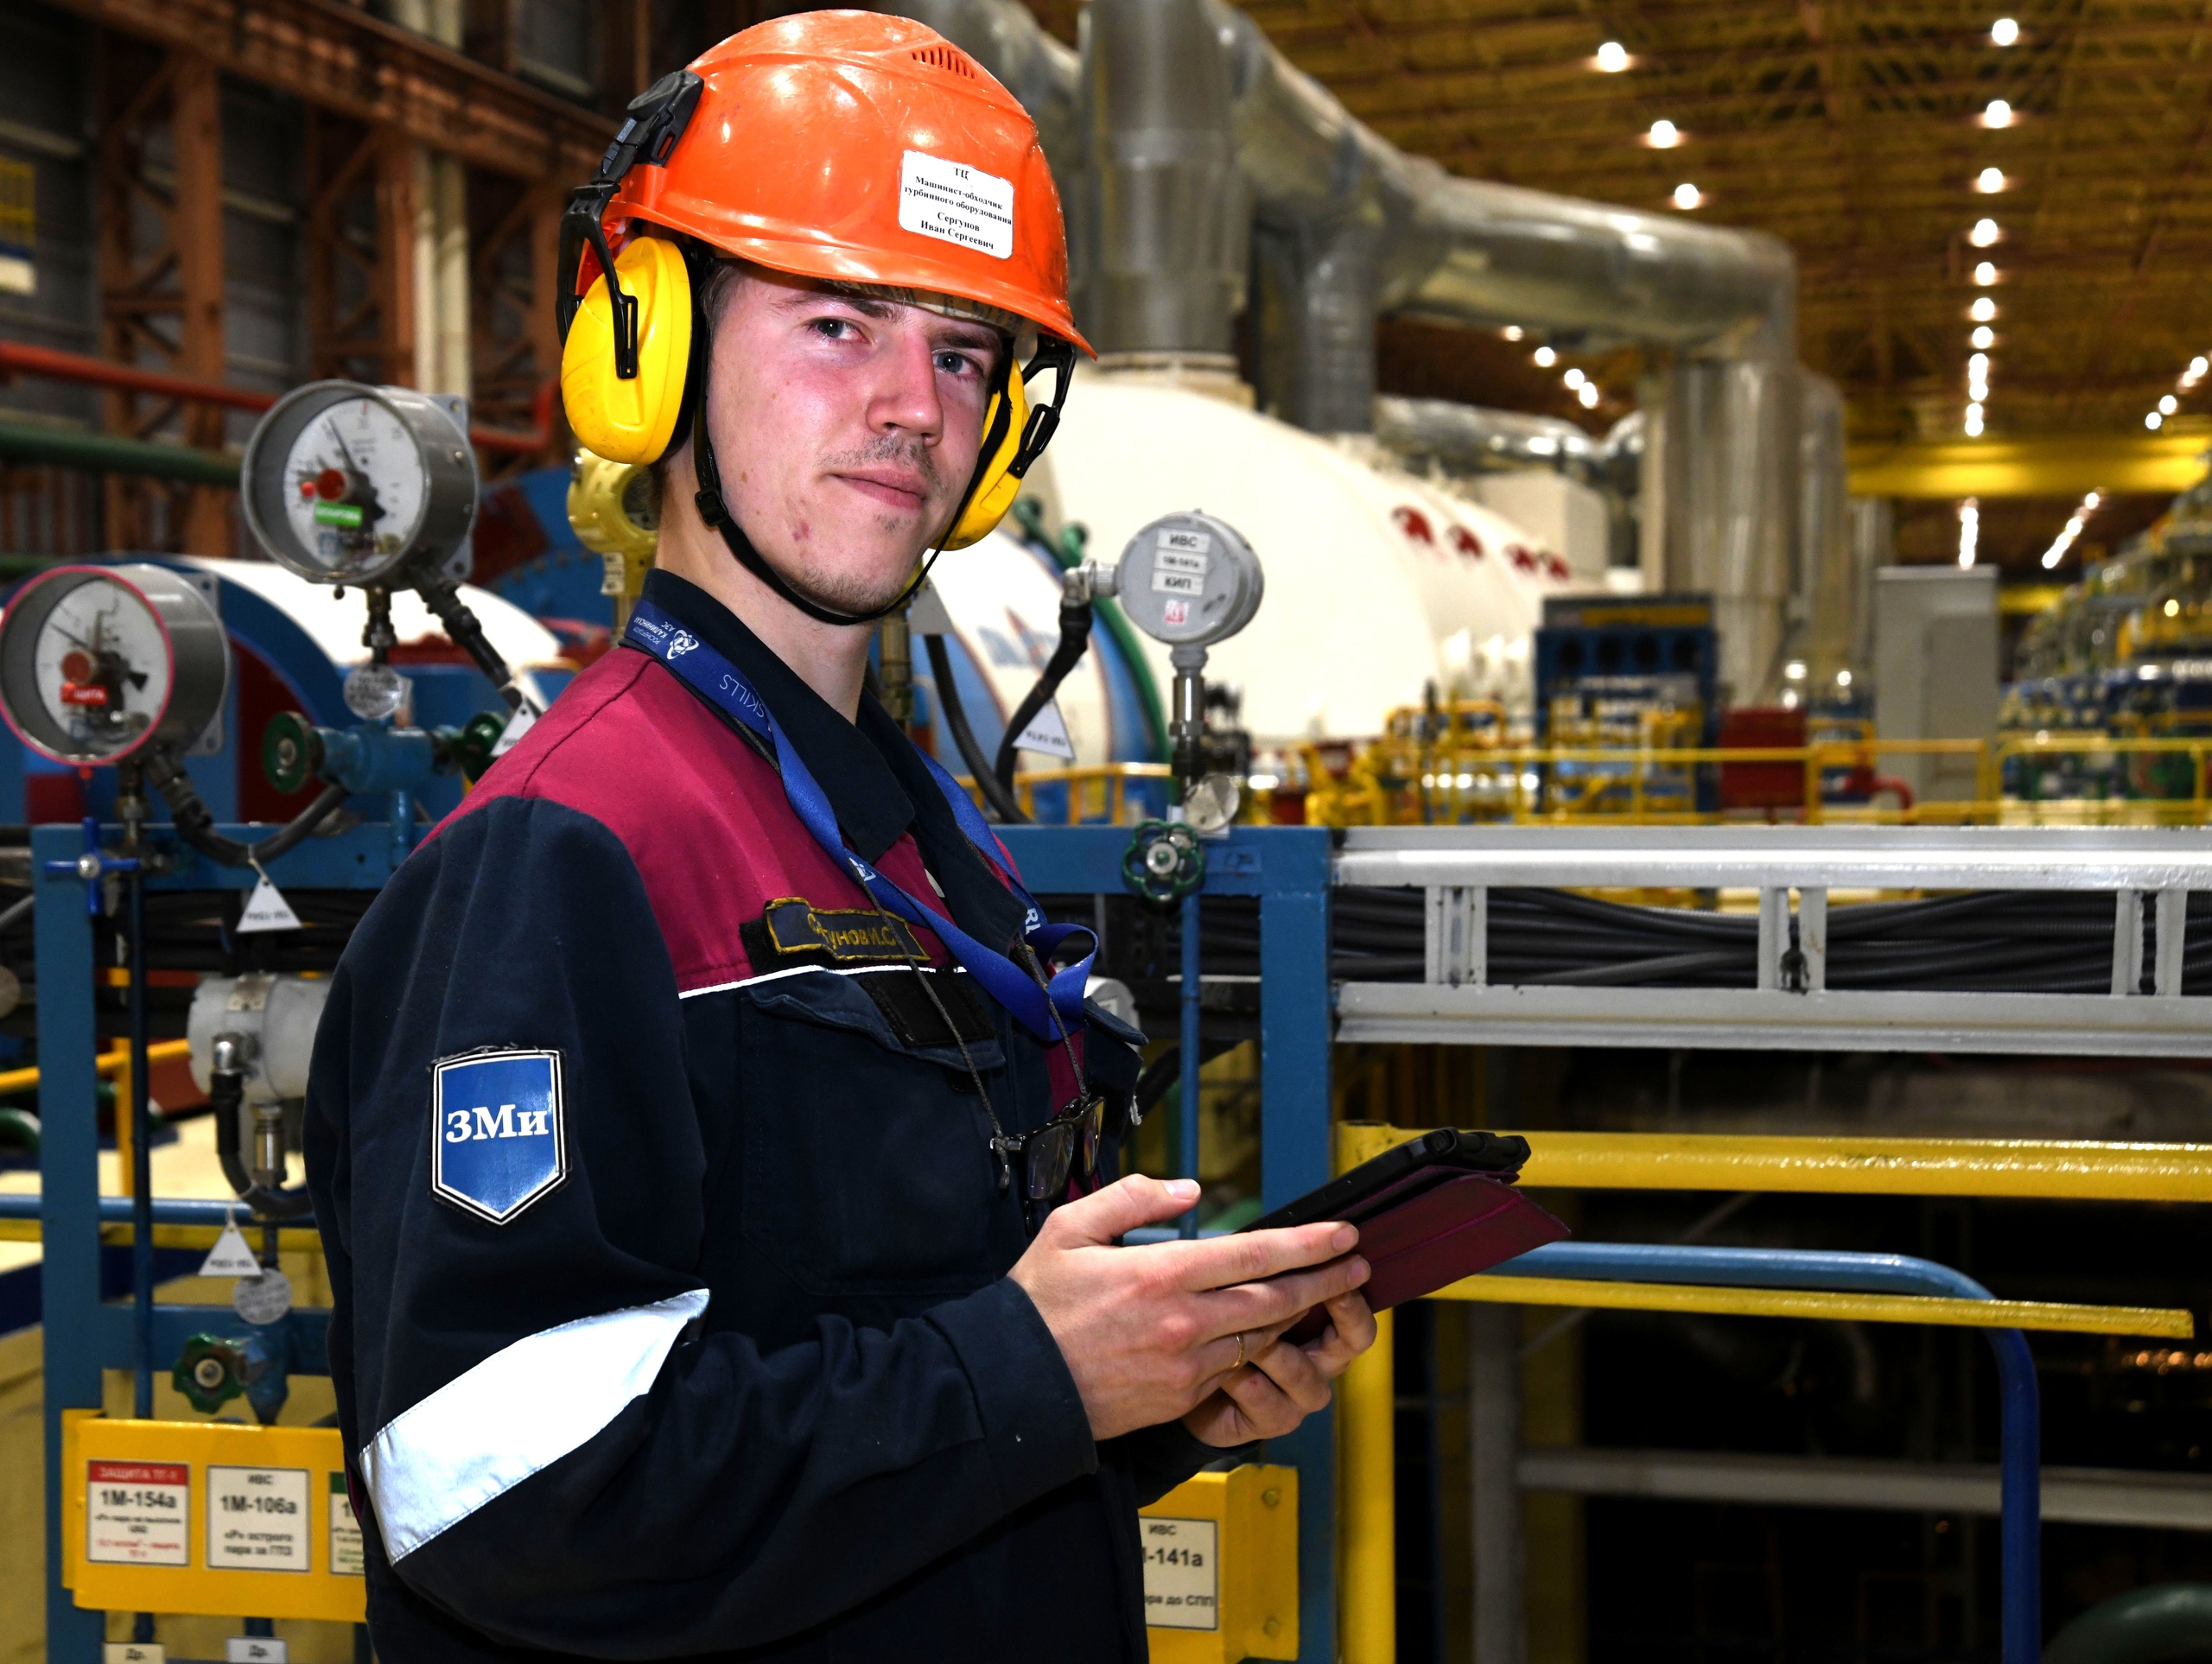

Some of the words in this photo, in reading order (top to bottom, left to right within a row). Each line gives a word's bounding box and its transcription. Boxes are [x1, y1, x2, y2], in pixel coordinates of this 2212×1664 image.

[953, 167, 969, 181] ТЦ
[915, 175, 1003, 210] Машинист-обходчик
[904, 186, 954, 206] турбинного
[956, 201, 1012, 225] оборудования
[937, 212, 980, 232] Сергунов
[920, 220, 945, 234] Иван
[947, 227, 994, 250] Сергеевич
[1169, 534, 1198, 548] ИВС
[1164, 576, 1192, 588] КИП
[661, 621, 676, 632] АЭС
[719, 674, 765, 718] SKILLS
[101, 1489, 178, 1508] 1М-154а
[221, 1496, 297, 1514] 1М-106а
[1148, 1524, 1177, 1536] ИВС
[1141, 1546, 1204, 1567] -141а
